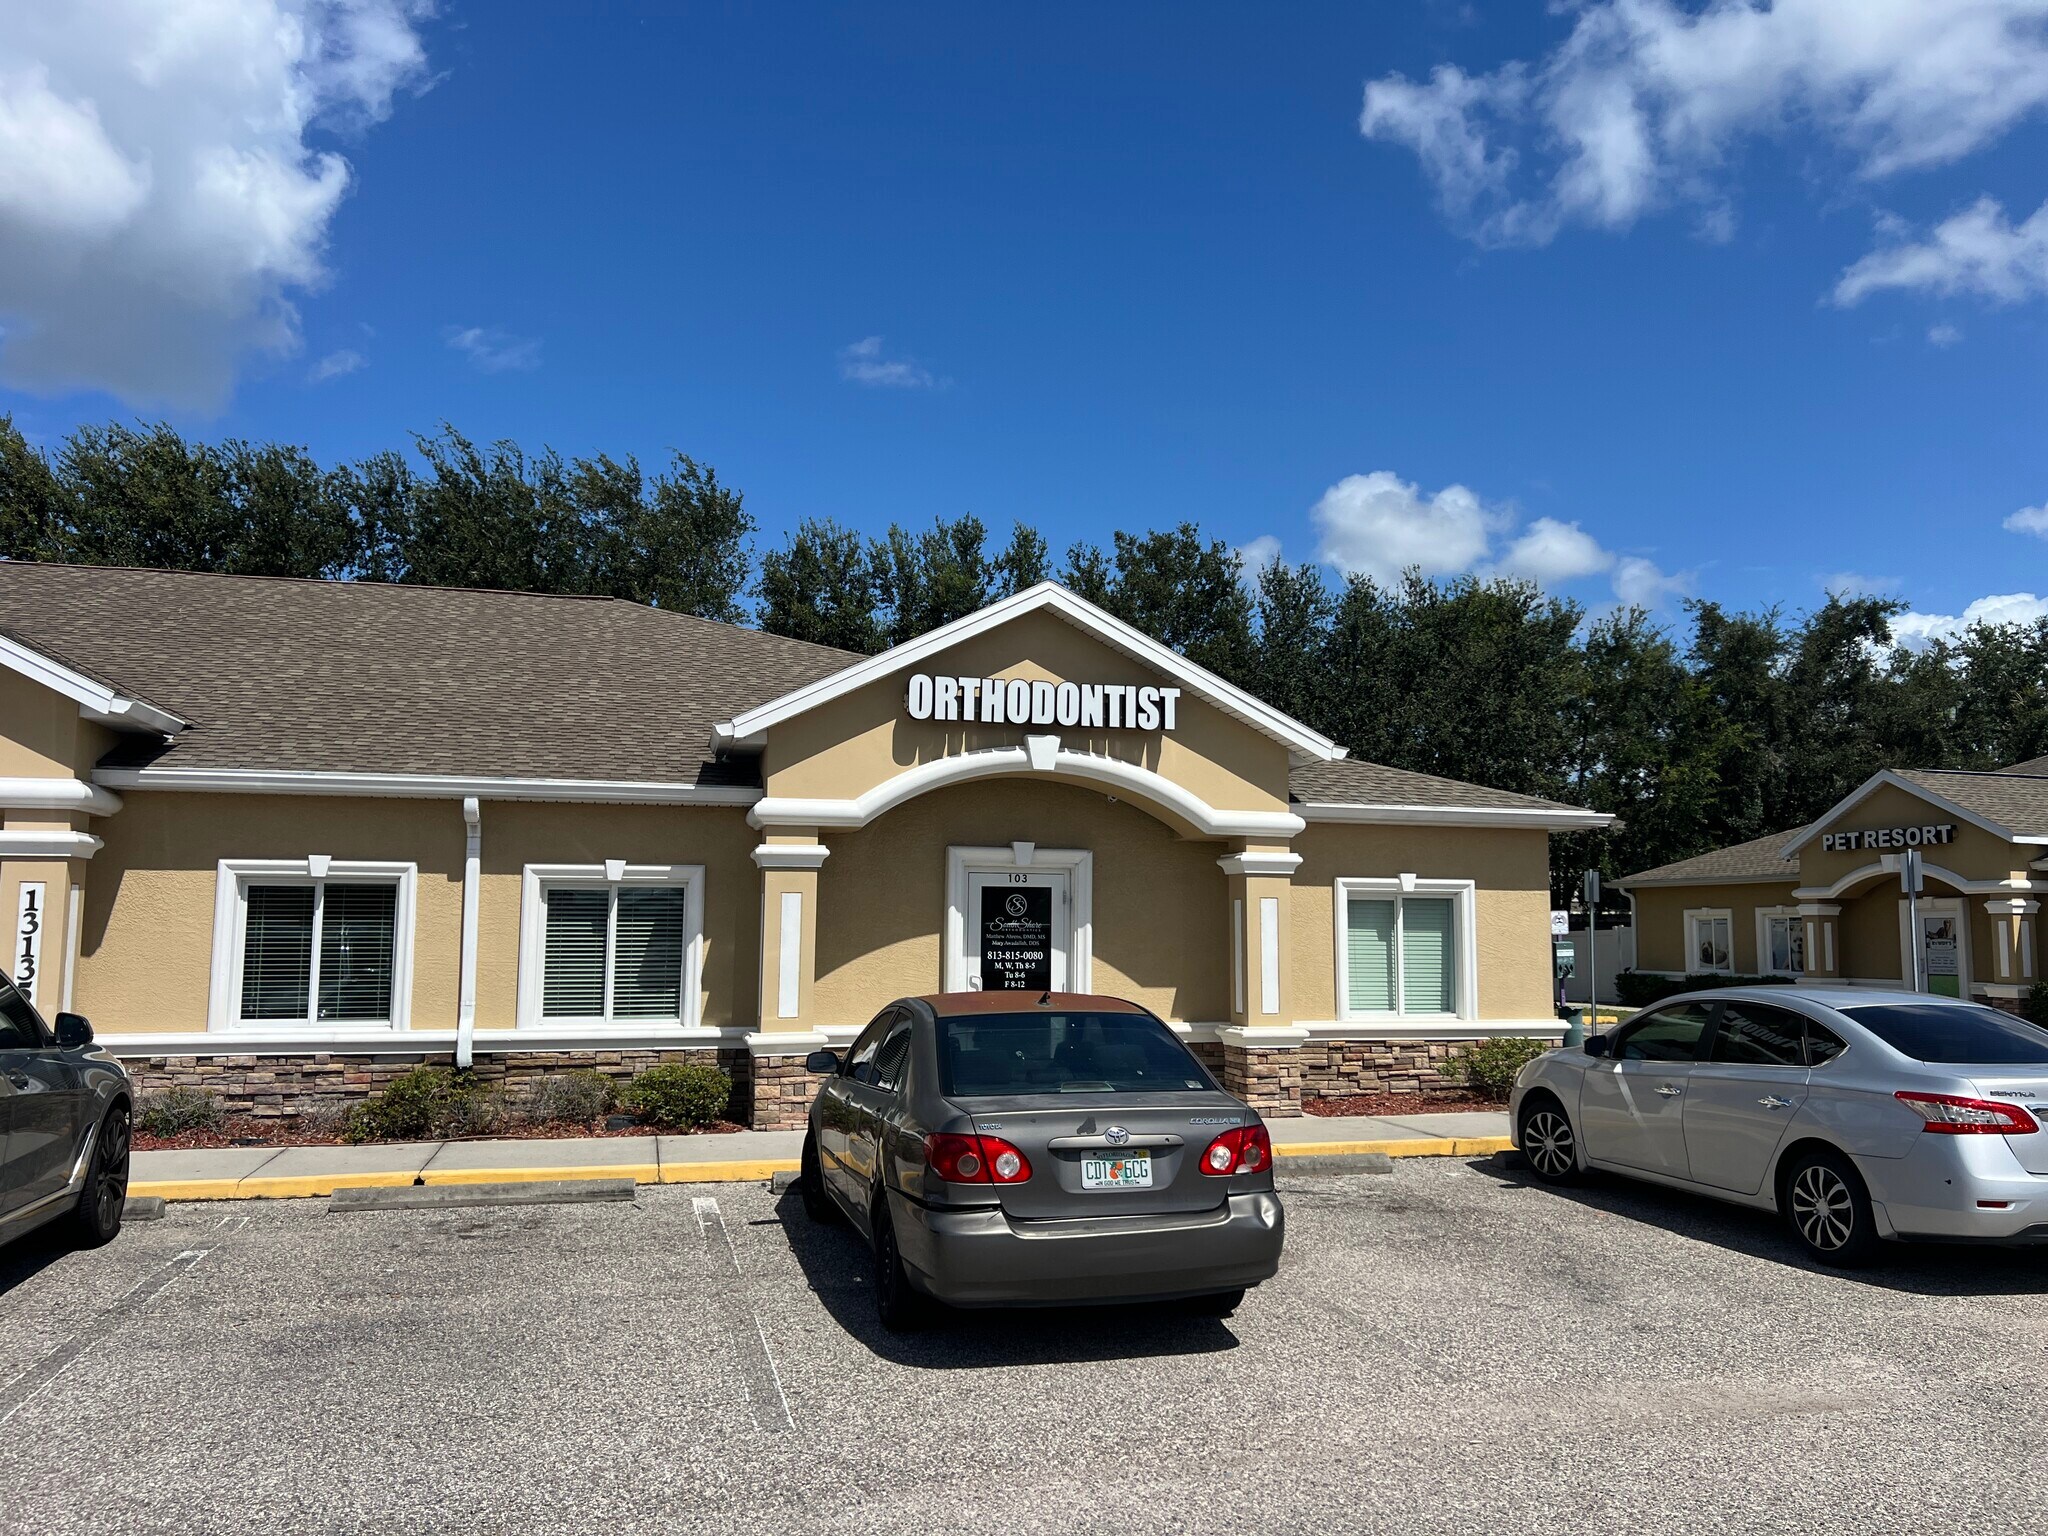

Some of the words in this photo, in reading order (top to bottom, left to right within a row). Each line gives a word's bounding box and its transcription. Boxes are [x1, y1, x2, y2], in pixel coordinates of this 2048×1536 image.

[908, 674, 1180, 730] ORTHODONTIST
[1822, 832, 1860, 852] PET
[1864, 824, 1951, 848] RESORT
[1008, 874, 1028, 883] 103
[987, 951, 1044, 960] 813-815-0080
[1189, 1117, 1229, 1125] COROLLA
[1124, 1160, 1148, 1178] 6CG
